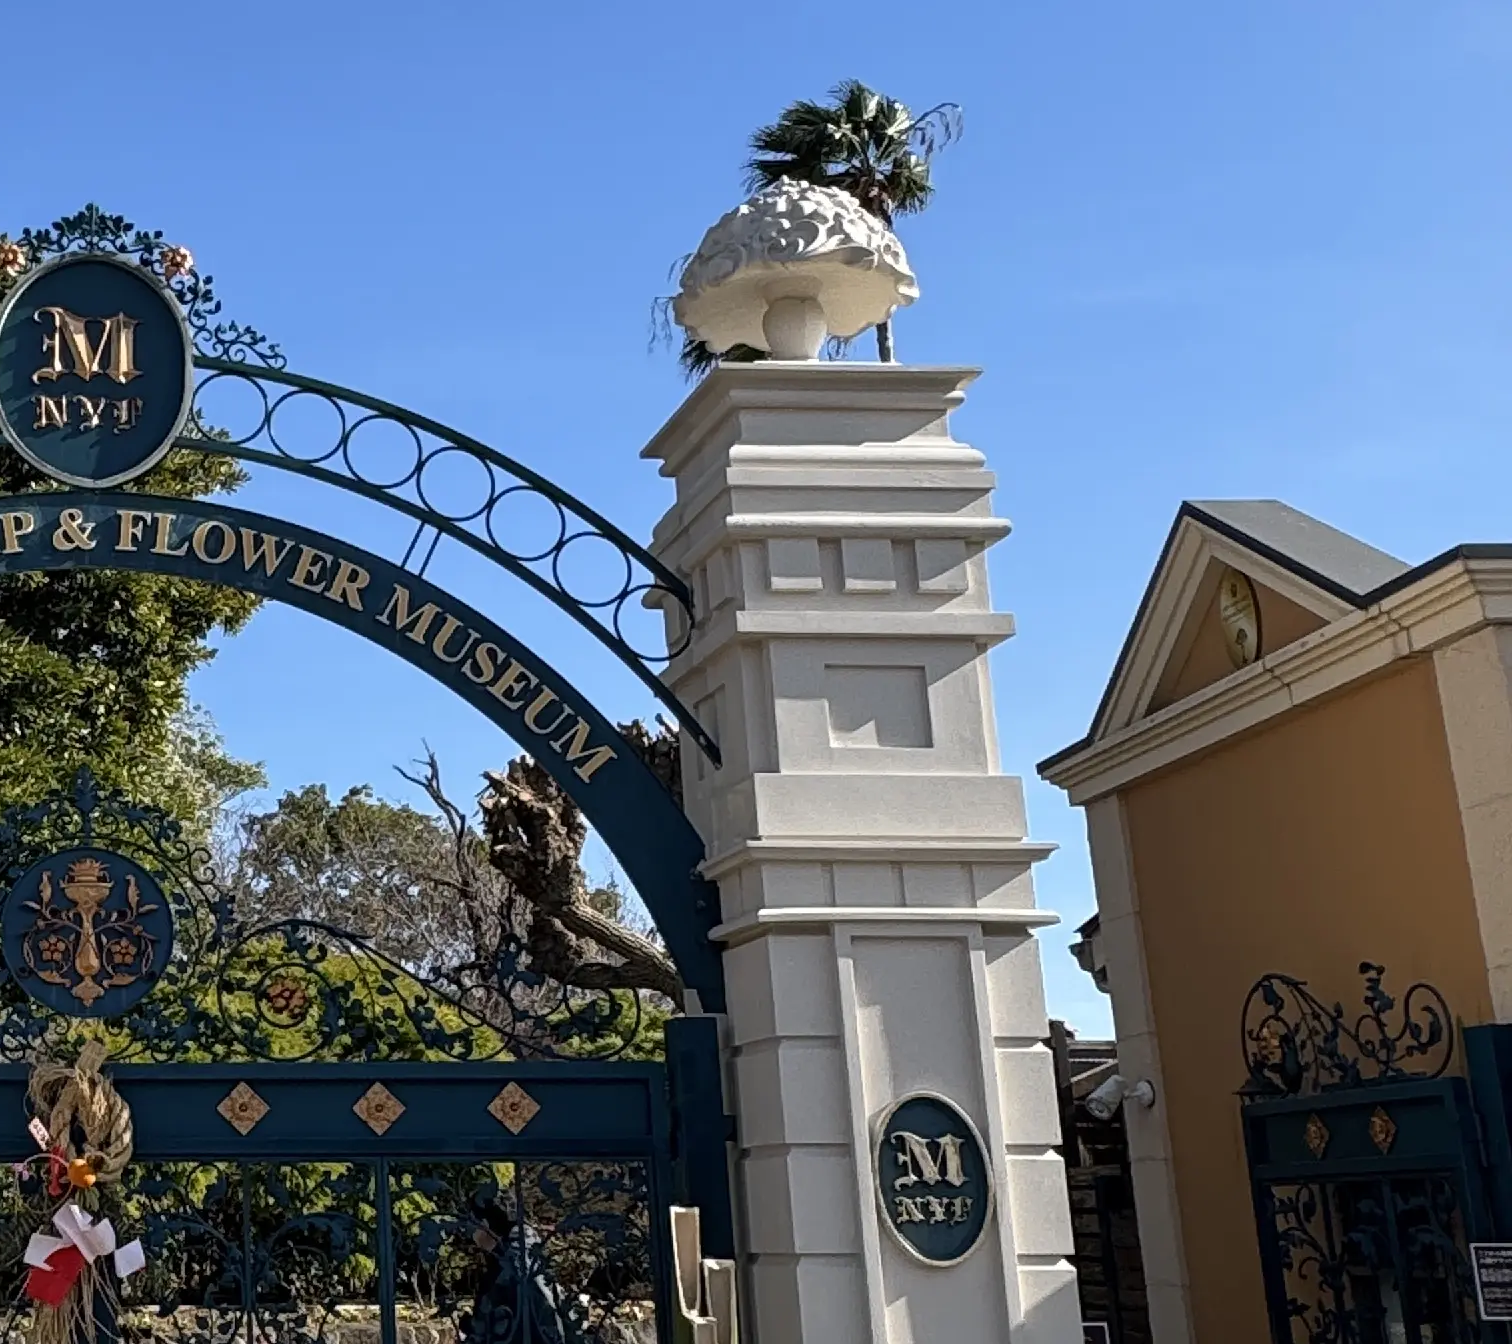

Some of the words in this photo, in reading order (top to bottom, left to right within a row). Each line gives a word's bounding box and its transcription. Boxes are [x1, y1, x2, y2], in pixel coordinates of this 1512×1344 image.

[33, 306, 144, 385] M
[52, 508, 97, 551] &
[114, 510, 372, 612] FLOWER
[375, 582, 619, 785] MUSEUM
[890, 1131, 972, 1192] M
